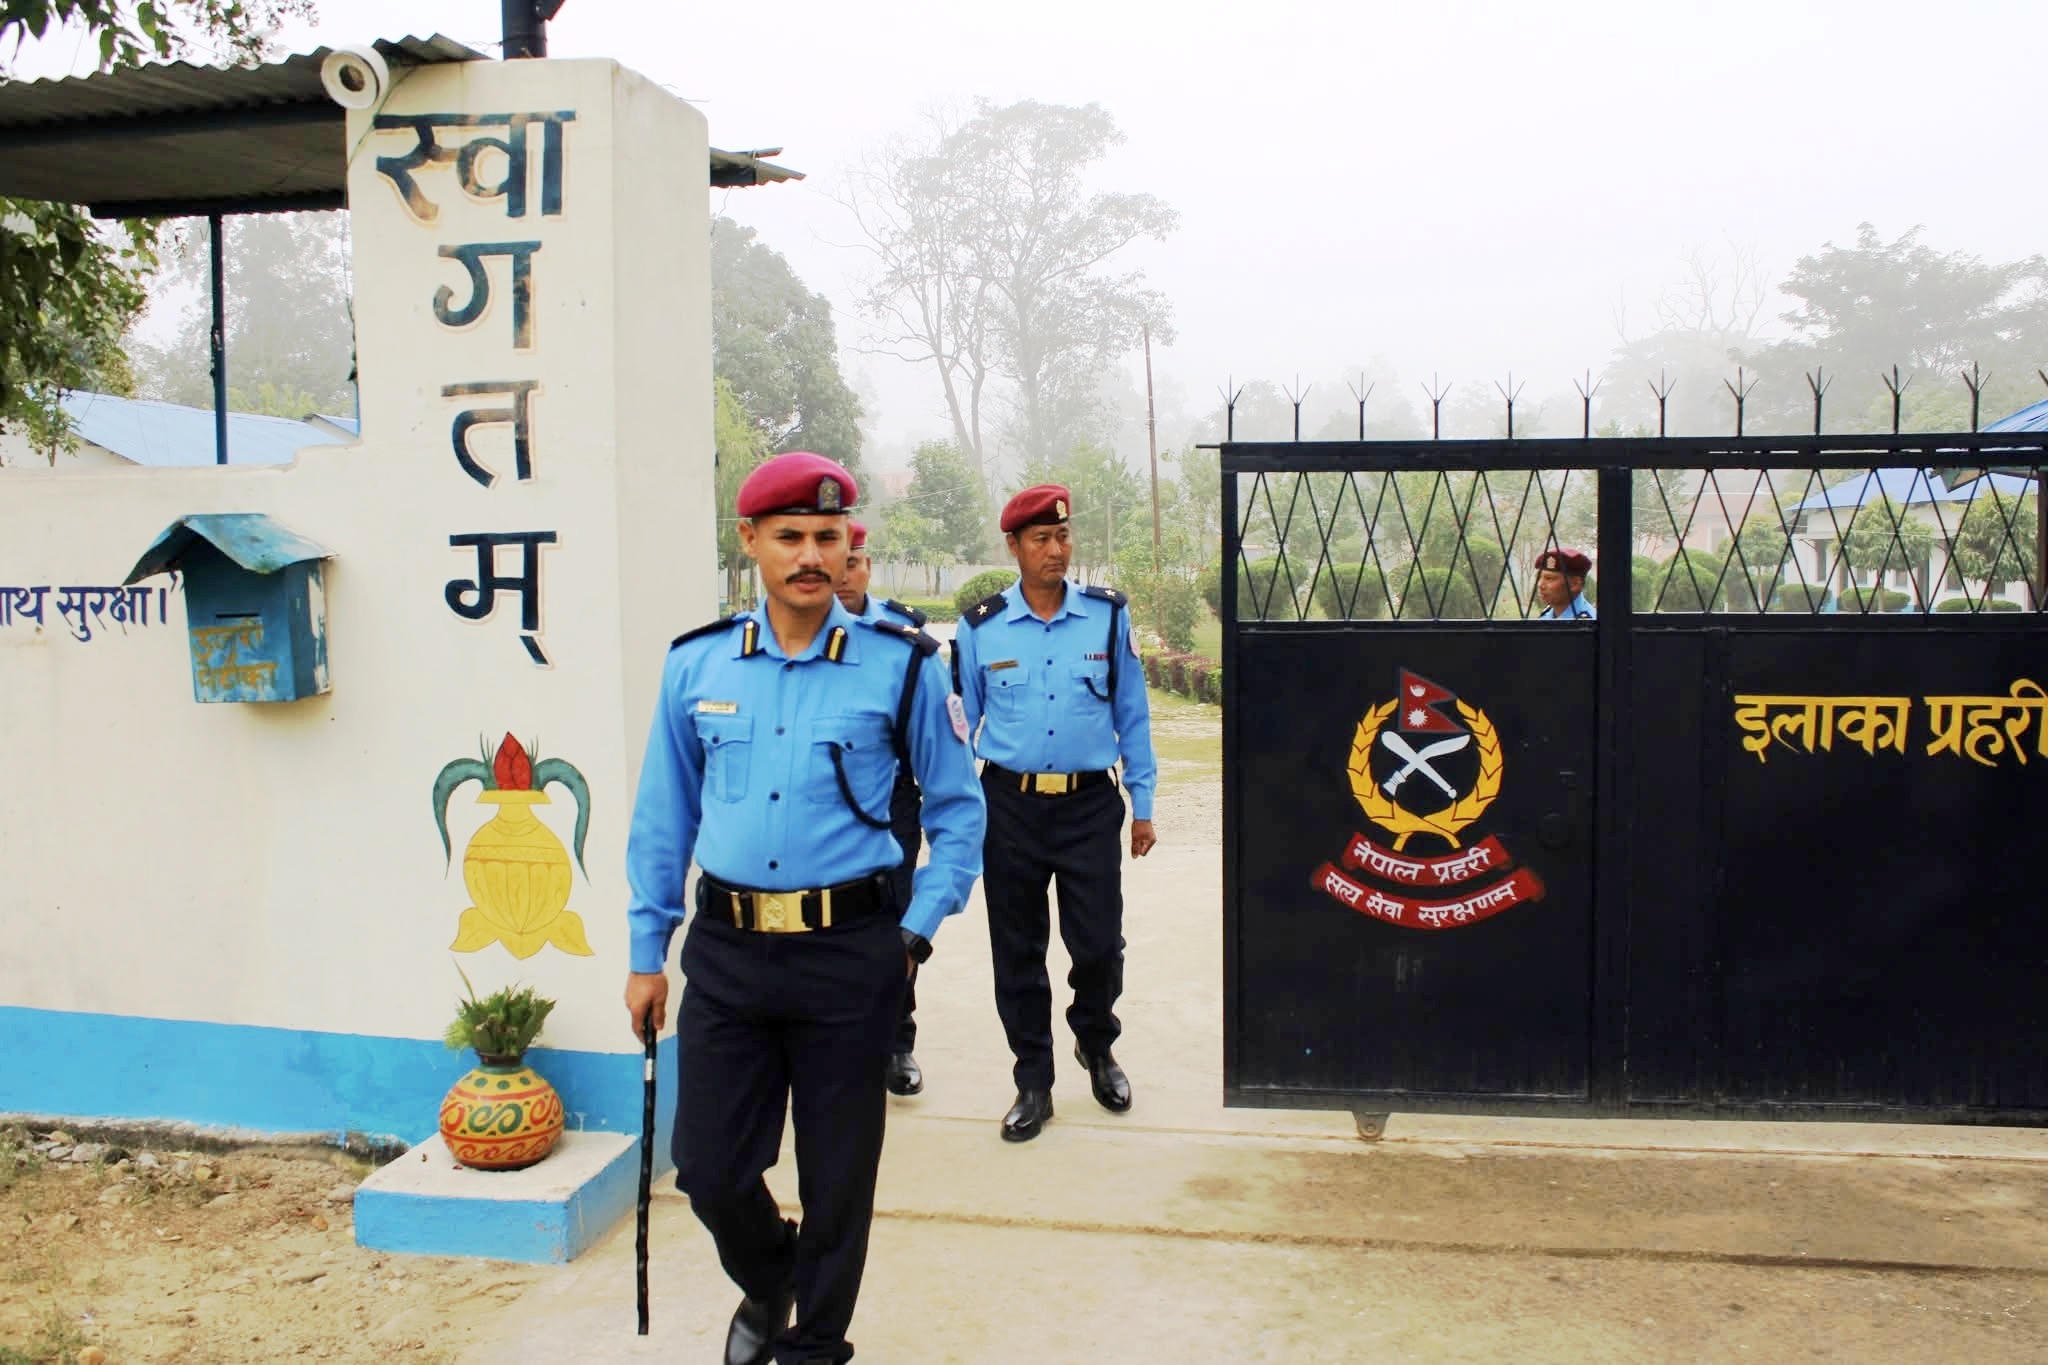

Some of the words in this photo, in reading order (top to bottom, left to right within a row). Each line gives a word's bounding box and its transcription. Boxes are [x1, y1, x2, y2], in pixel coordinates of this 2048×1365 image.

[0, 586, 51, 625] ाथ
[1734, 694, 1912, 763] इलाका
[1923, 678, 2048, 767] प्रहरी
[1353, 841, 1425, 881] नेपाल
[1431, 847, 1491, 883] प्रहरी
[1325, 871, 1363, 905] सत्य
[1366, 892, 1405, 920] सेवा
